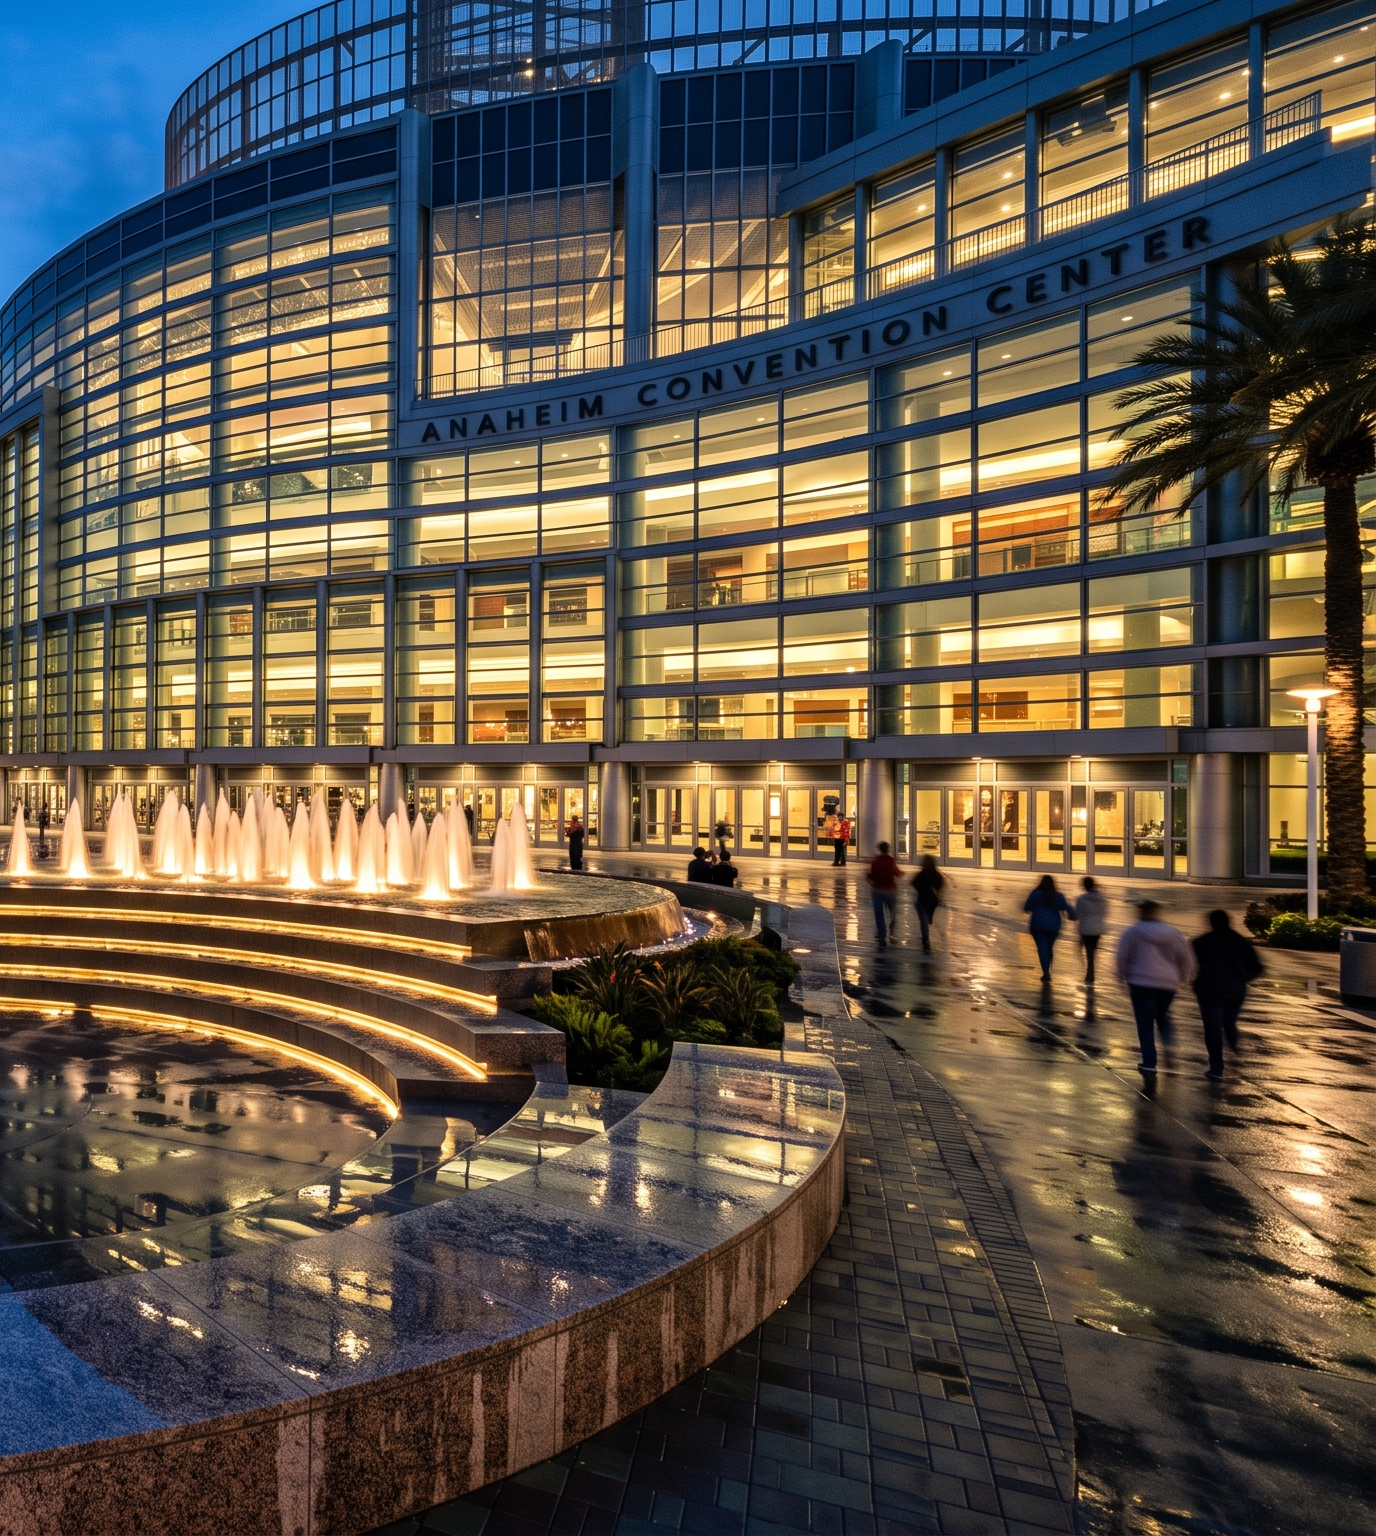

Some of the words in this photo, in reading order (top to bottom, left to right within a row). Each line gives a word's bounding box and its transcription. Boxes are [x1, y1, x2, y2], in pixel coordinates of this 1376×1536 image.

[421, 394, 604, 442] ANAHEIM
[637, 305, 947, 406] CONVENTION
[986, 216, 1210, 314] CENTER
